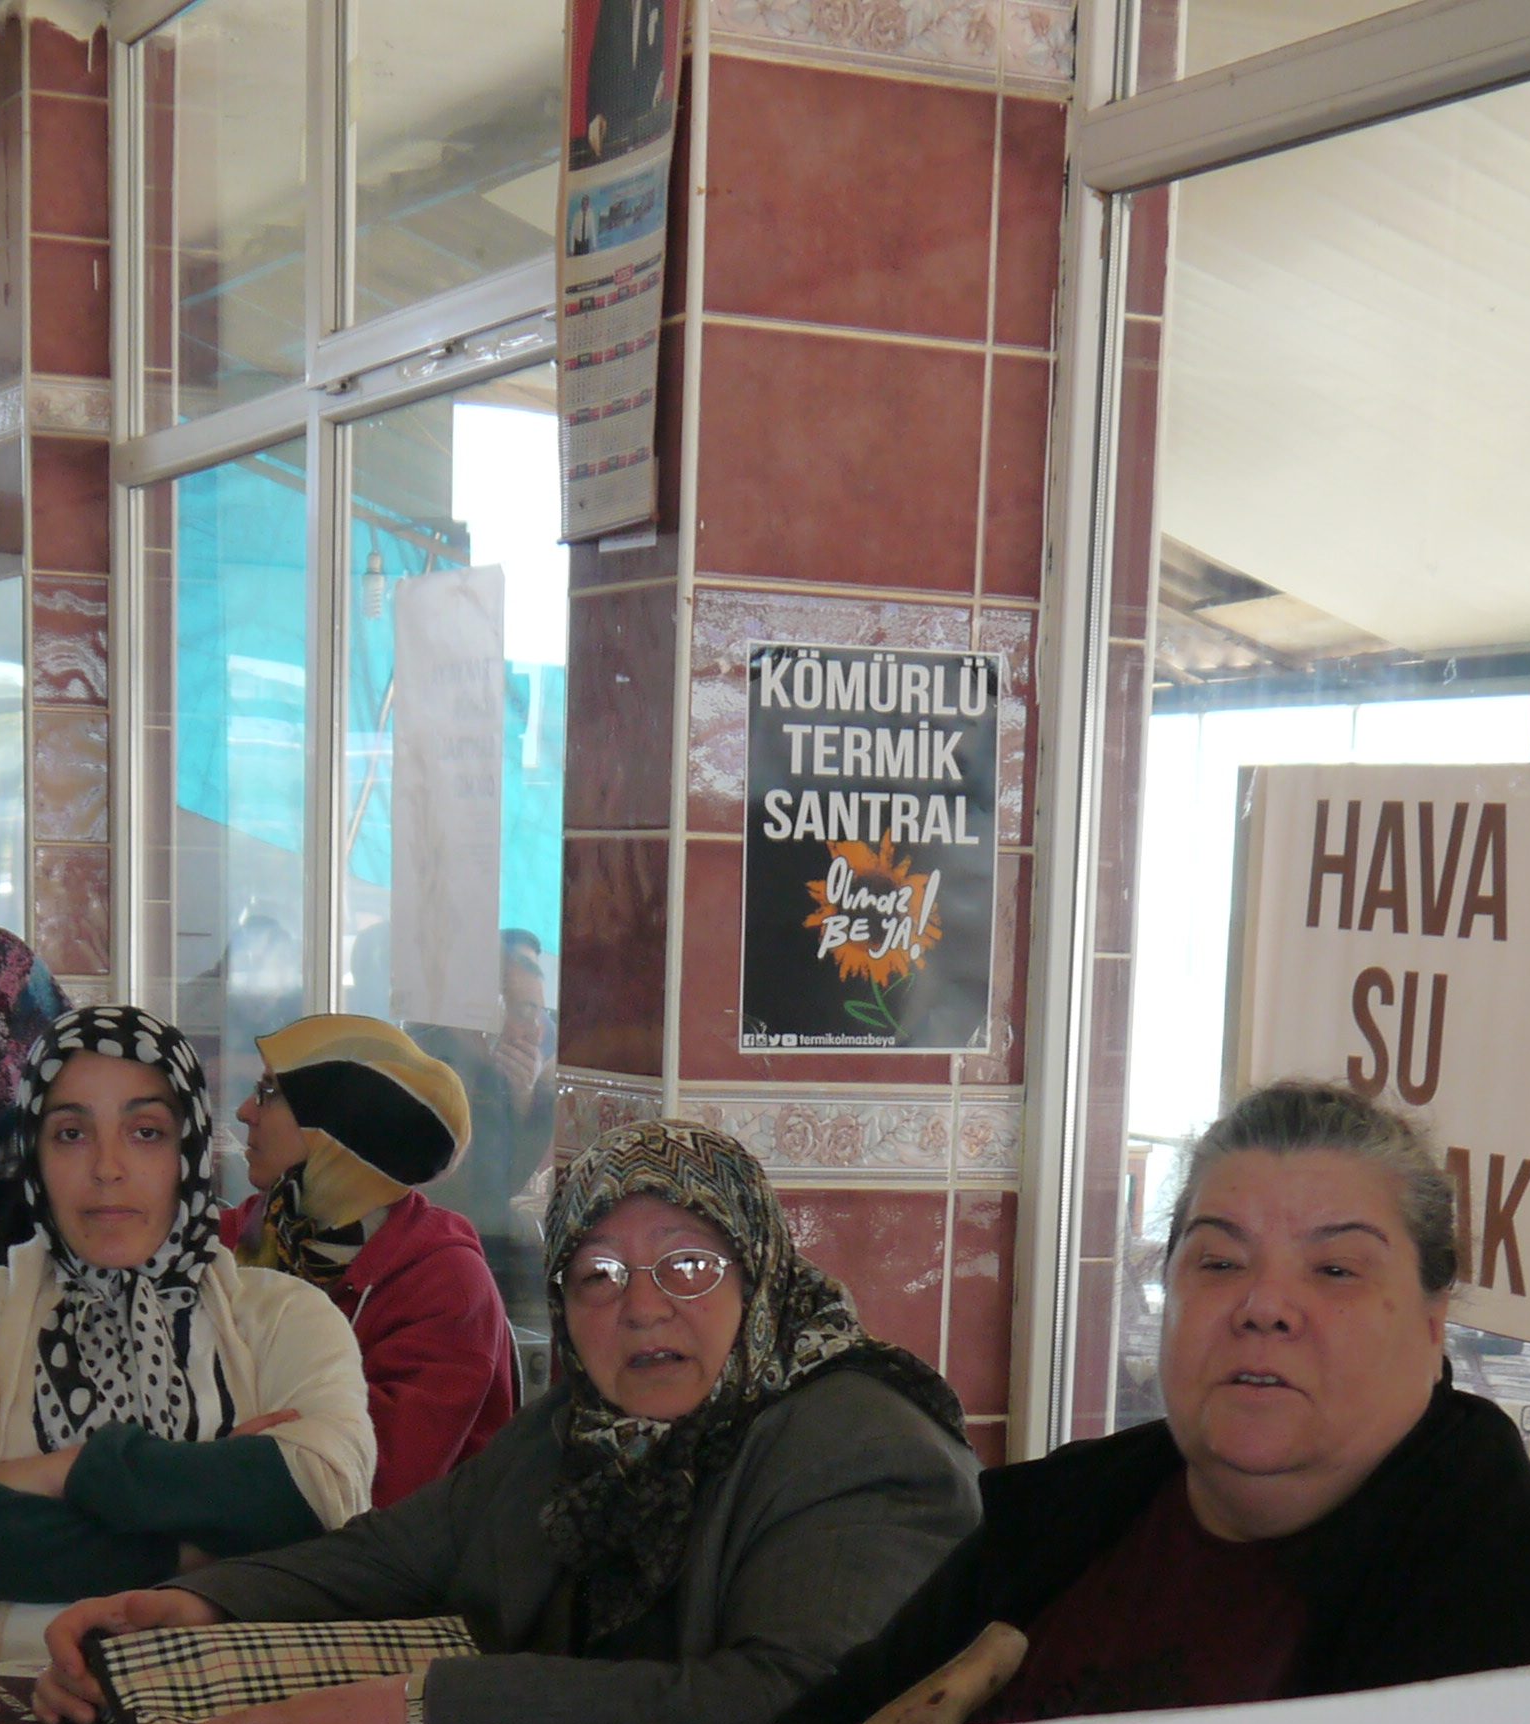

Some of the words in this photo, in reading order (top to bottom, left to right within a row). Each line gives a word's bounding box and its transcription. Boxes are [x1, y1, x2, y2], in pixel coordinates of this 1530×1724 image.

[760, 649, 988, 717] KÖMÜRLÜ
[782, 720, 964, 781] TERMİK
[763, 788, 980, 844] SANTRAL
[1306, 799, 1508, 942] HAVA
[816, 914, 871, 960] BE
[798, 1032, 896, 1049] termikolmazbeya
[1346, 966, 1449, 1107] SU
